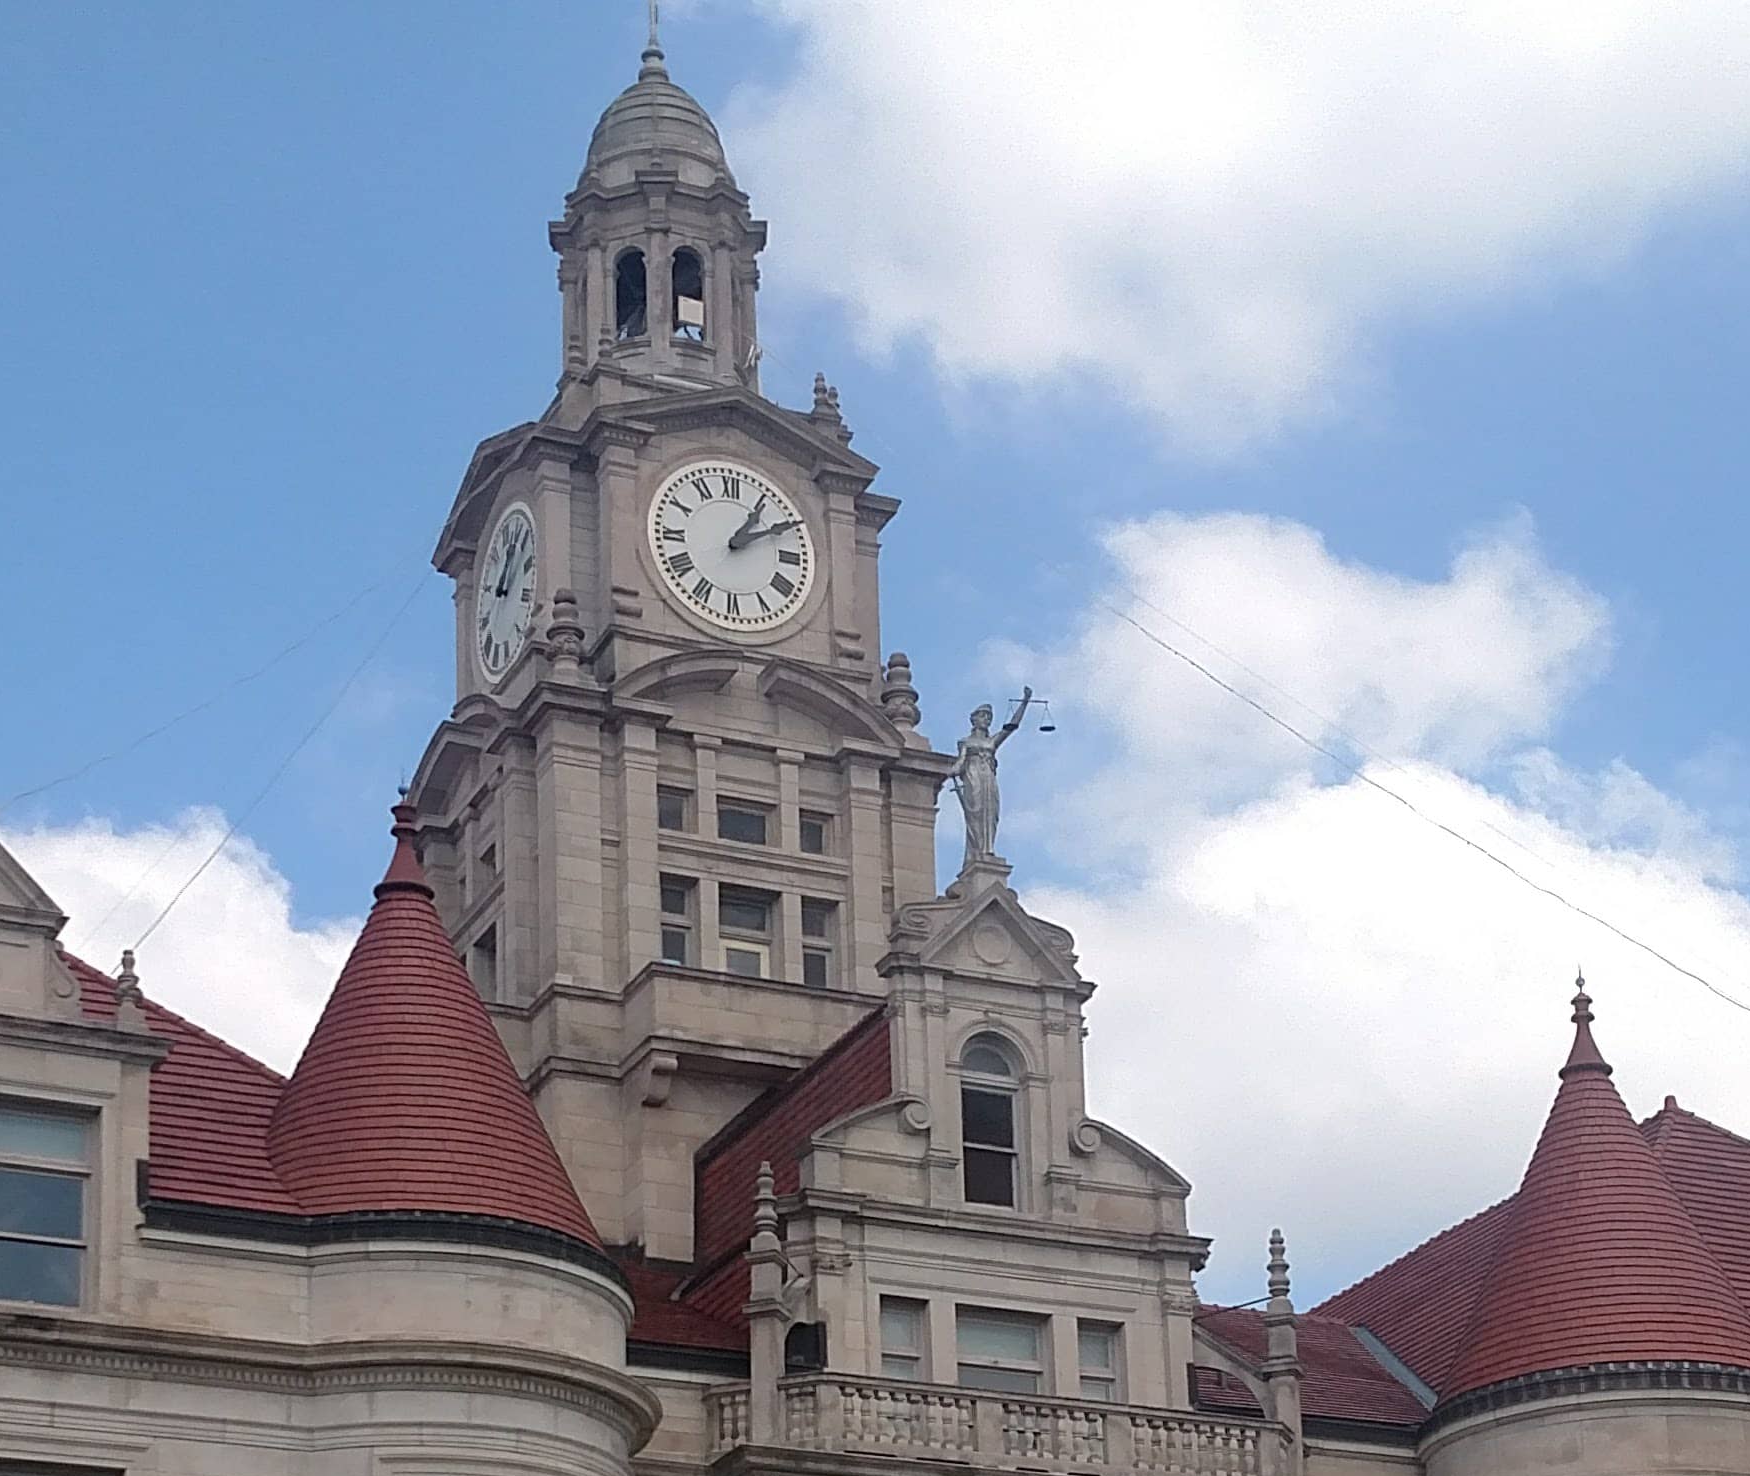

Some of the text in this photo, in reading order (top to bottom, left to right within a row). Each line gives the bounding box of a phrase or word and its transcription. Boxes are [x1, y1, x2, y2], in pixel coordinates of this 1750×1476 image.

[691, 477, 713, 502] XI
[721, 476, 740, 500] XII
[669, 496, 693, 517] X
[778, 549, 801, 566] III
